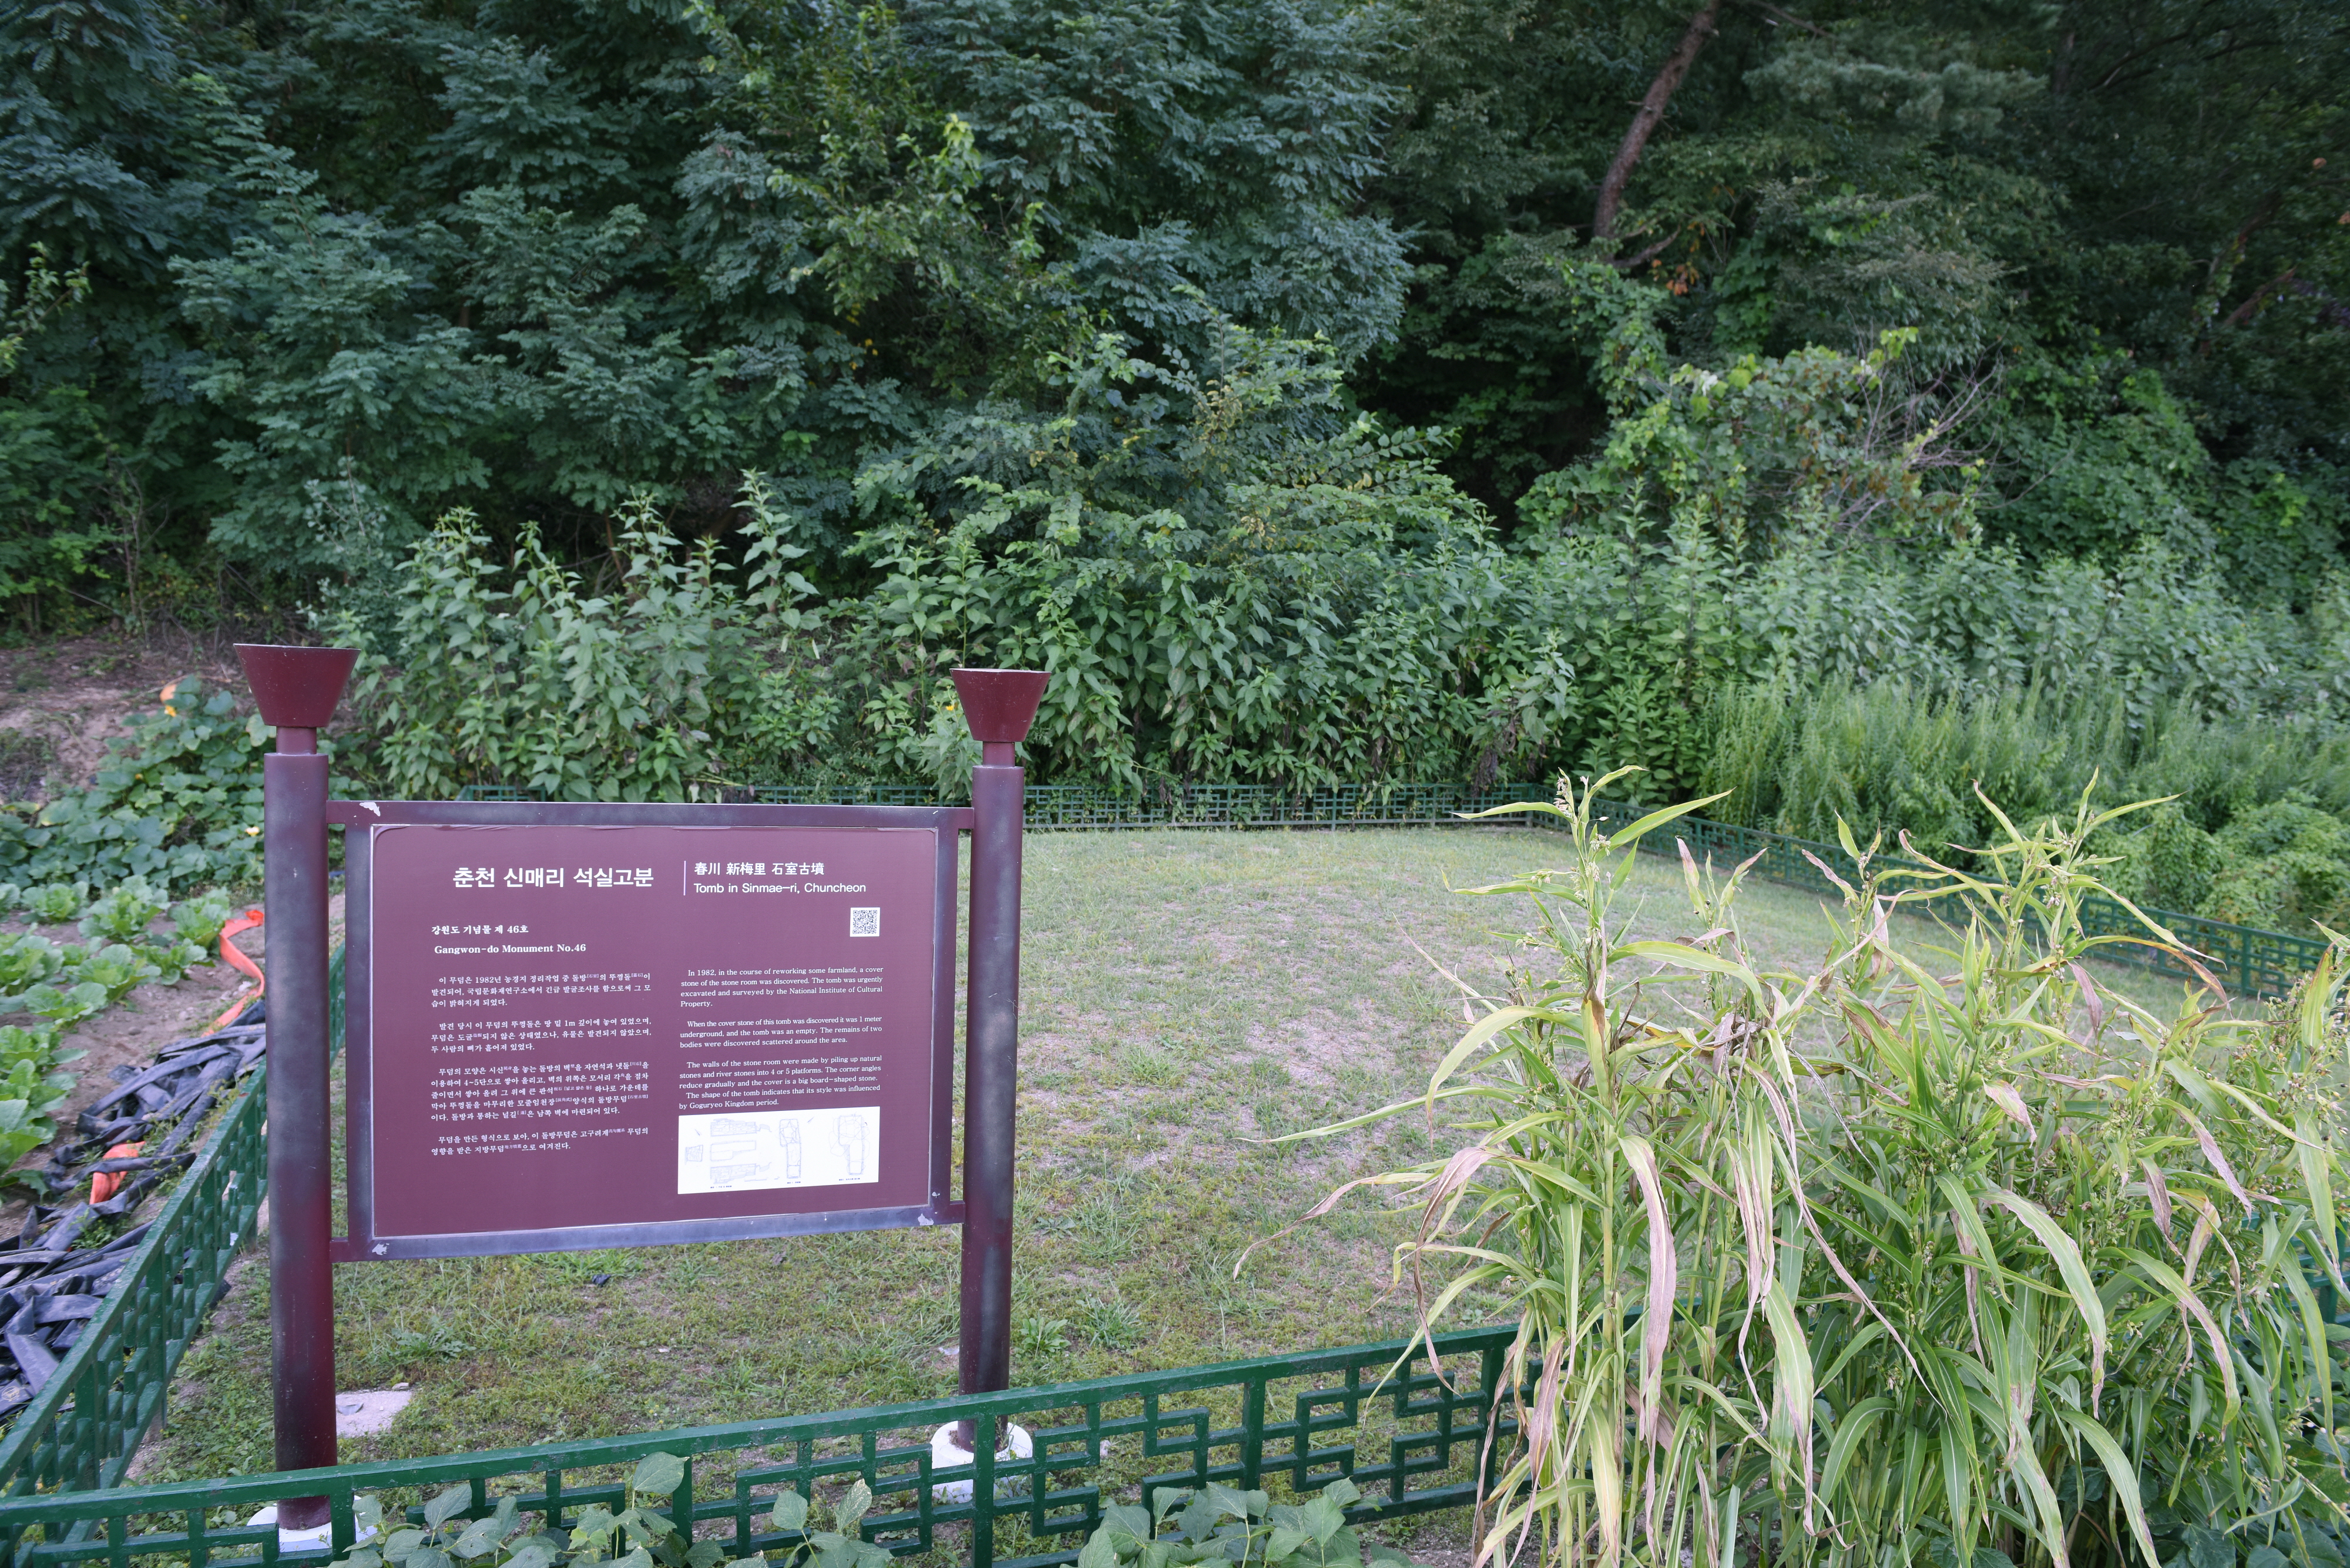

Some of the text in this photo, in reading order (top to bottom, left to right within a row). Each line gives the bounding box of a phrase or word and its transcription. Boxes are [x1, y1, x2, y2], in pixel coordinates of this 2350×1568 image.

[694, 862, 824, 875] 春川 新梅里 石室古墳
[453, 868, 654, 887] 춘천 신매리 석실고분
[693, 883, 724, 893] Tomb
[728, 883, 738, 892] in
[804, 883, 866, 892] Chuncheon
[431, 925, 460, 935] 강원도
[463, 925, 492, 934] 기념물
[494, 925, 503, 934] 제
[434, 945, 499, 955] Gangwon-do
[467, 986, 542, 995] 국립문화재연구소에서
[511, 1043, 535, 1051] 있었다.
[431, 1079, 461, 1087] 이용하여
[542, 1131, 578, 1139] 돌방무덤은
[431, 1147, 454, 1156] 영향을
[539, 1142, 570, 1150] 여겨진다.
